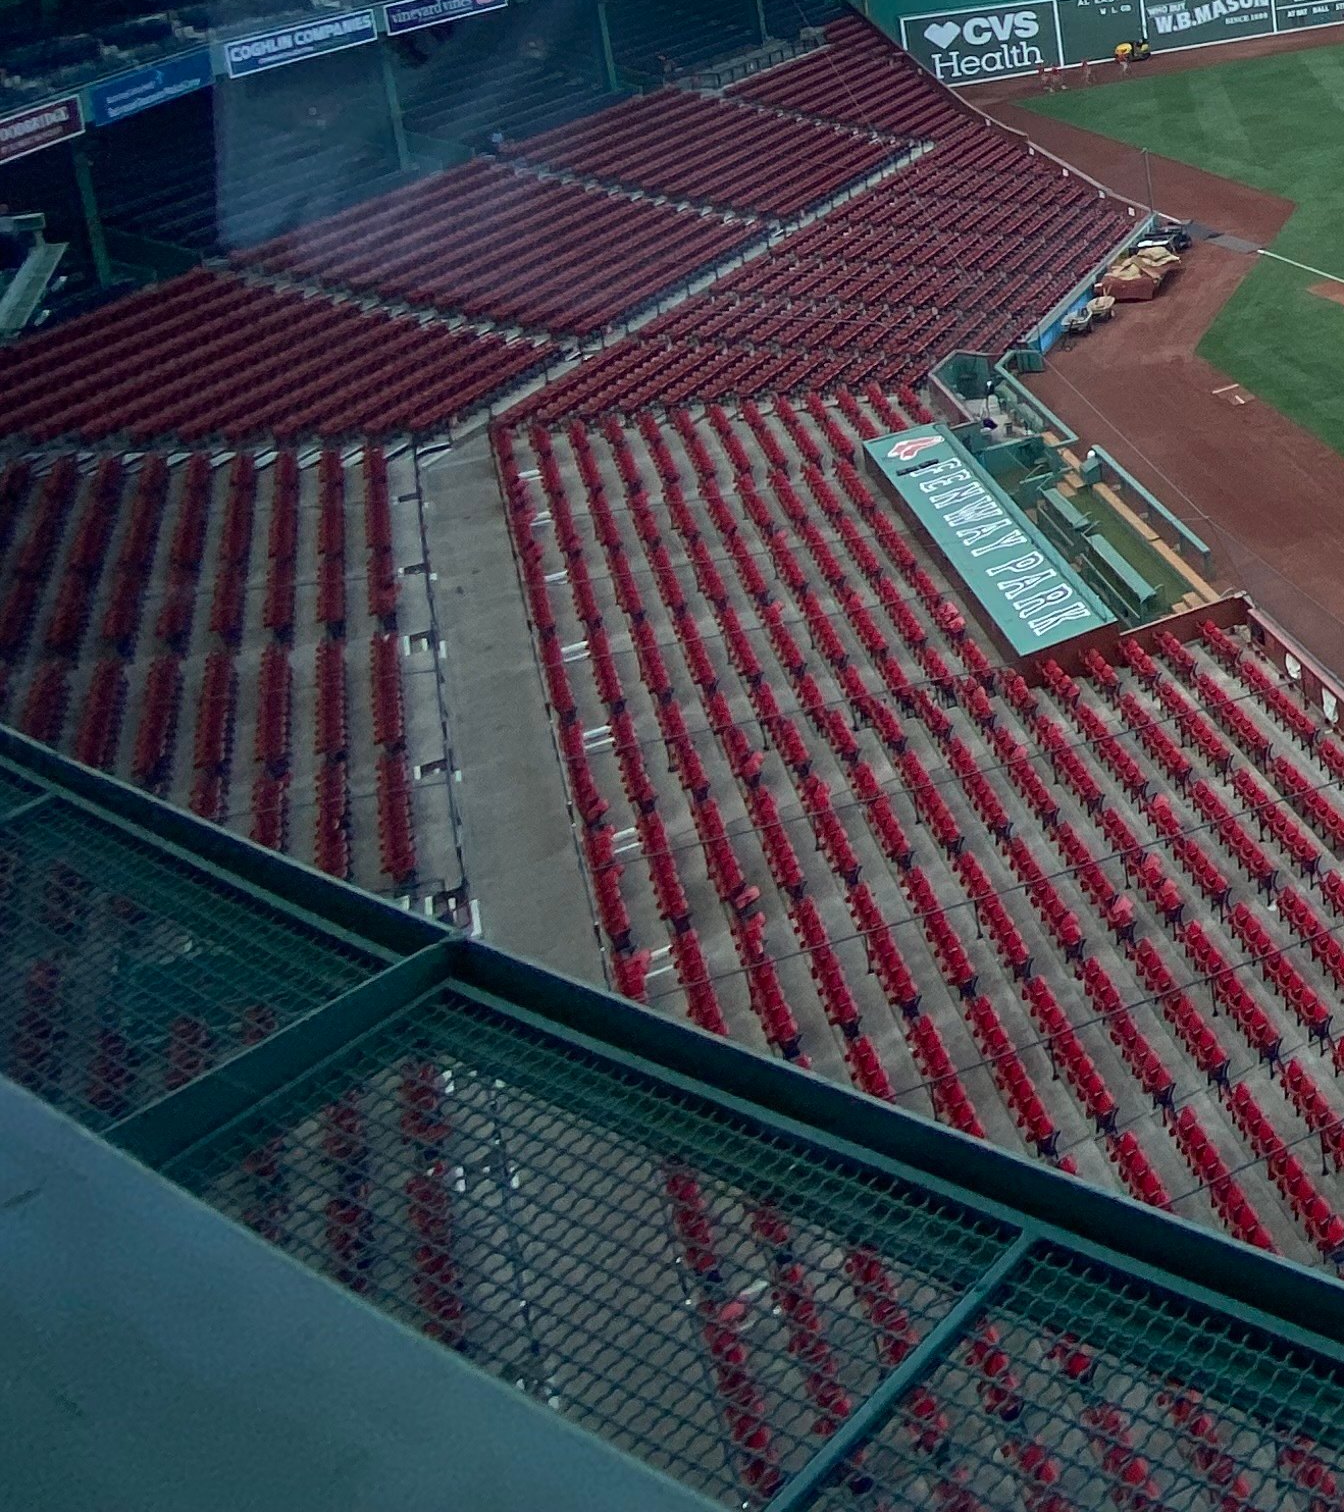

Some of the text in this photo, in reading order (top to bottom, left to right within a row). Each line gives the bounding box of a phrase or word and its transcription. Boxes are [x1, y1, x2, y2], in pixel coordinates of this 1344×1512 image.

[392, 0, 441, 24] vineyard
[1077, 0, 1090, 7] AL
[1169, 0, 1186, 12] BUY
[1312, 5, 1329, 14] BALL
[963, 10, 1039, 45] CVS
[1225, 16, 1249, 25] SINCE
[230, 34, 294, 62] COGHLIN
[294, 15, 371, 46] COMPANIES
[931, 41, 1044, 80] Health
[910, 457, 1091, 637] FENWAY PARK
